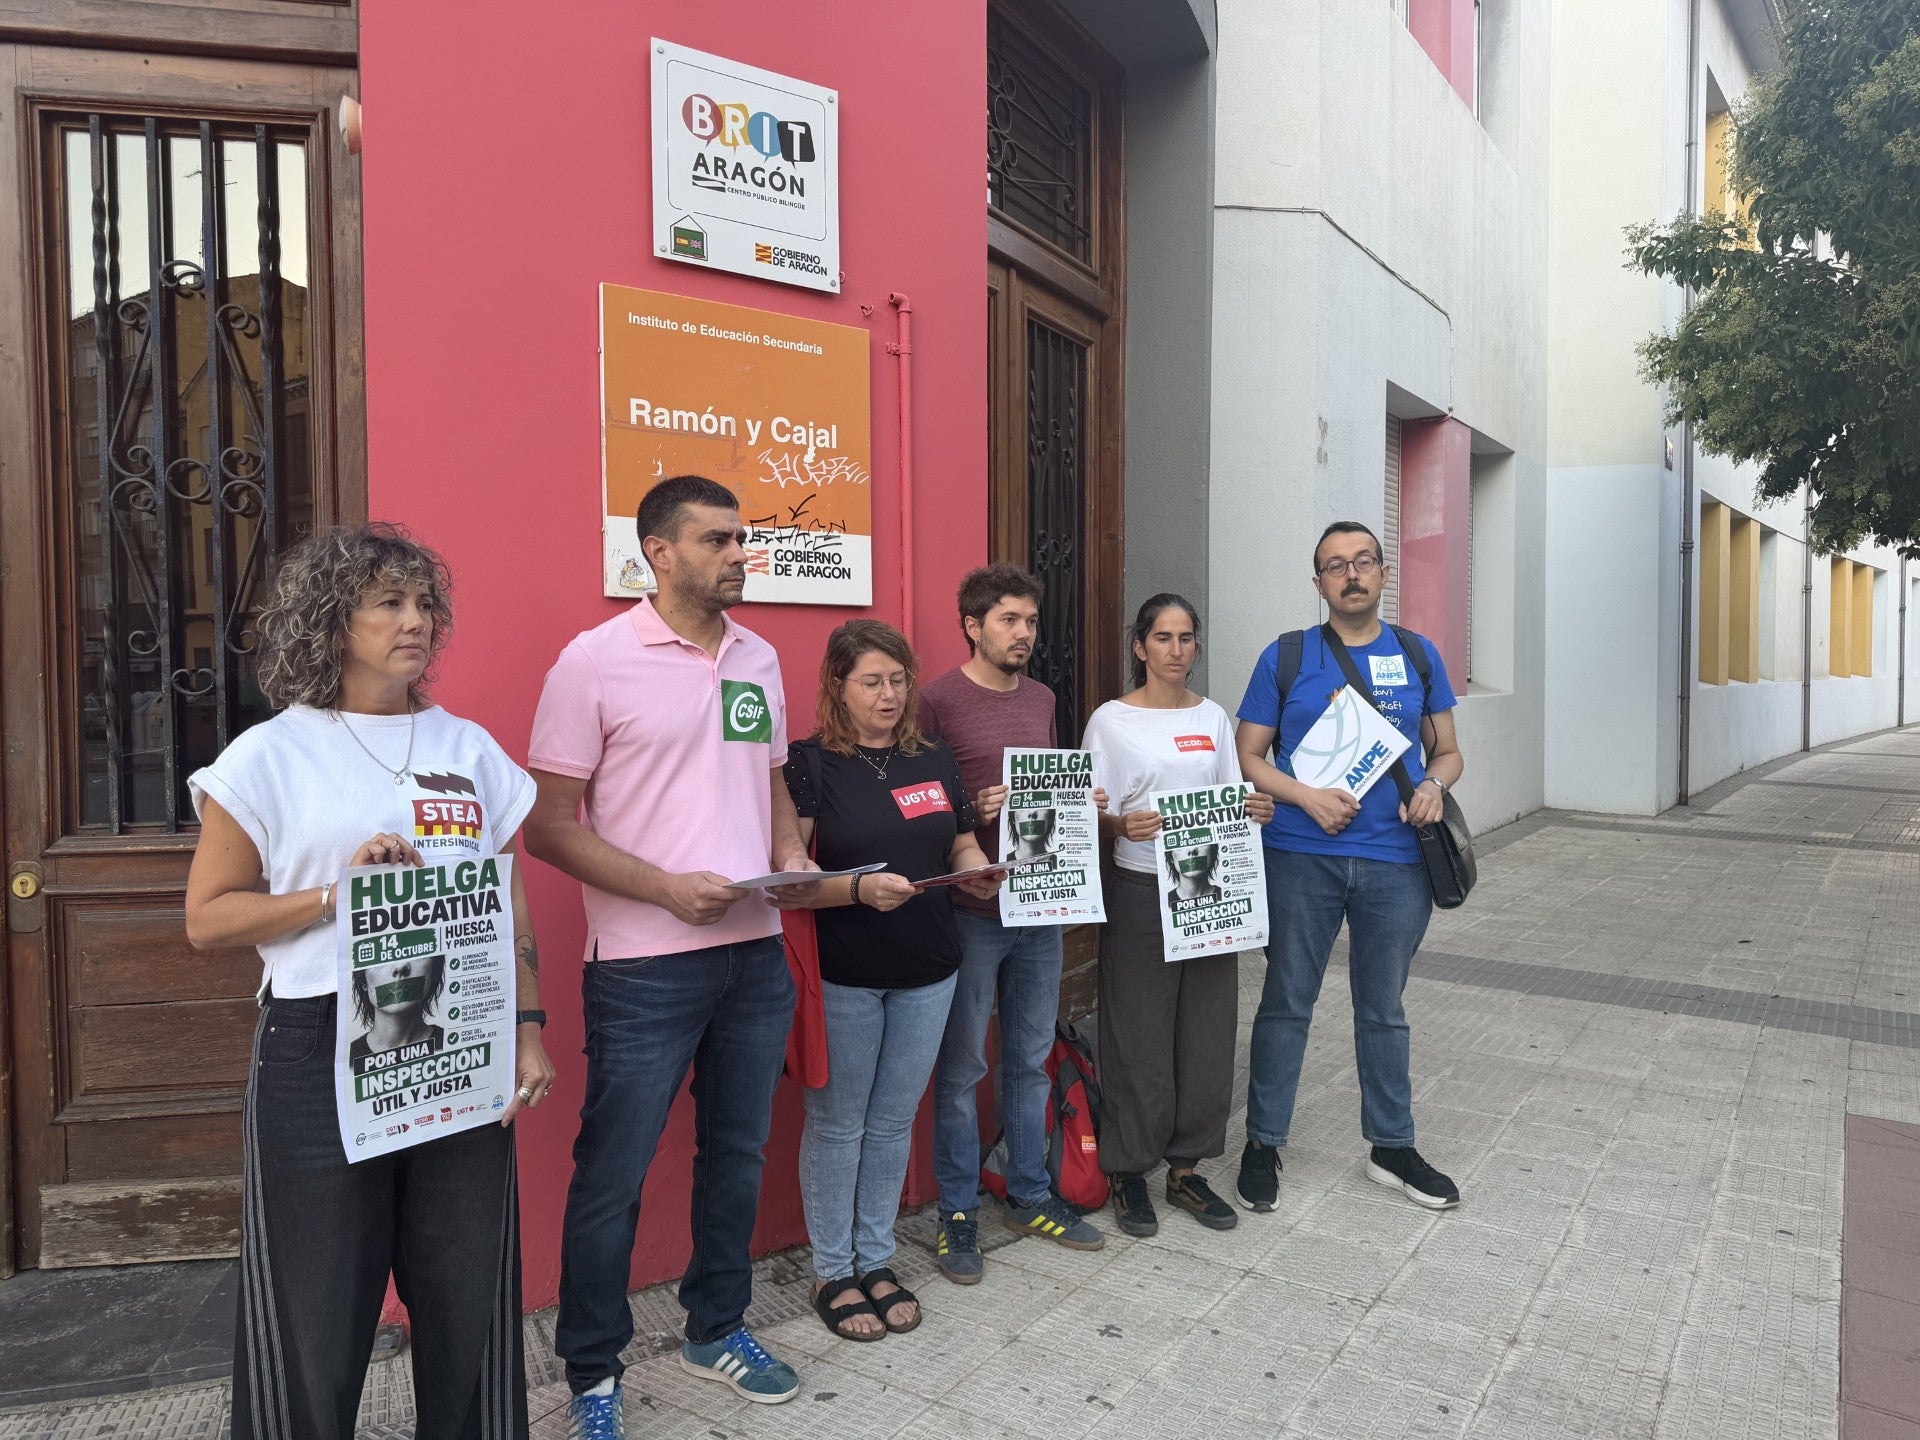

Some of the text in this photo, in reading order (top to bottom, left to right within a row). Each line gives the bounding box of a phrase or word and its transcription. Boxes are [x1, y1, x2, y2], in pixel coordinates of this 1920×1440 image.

[692, 95, 806, 161] BRIT
[692, 152, 805, 198] ARAGÓN
[727, 187, 805, 210] CENTRO PÚBLICO BILINGÜE
[772, 247, 820, 264] GOBIERNO
[773, 257, 785, 267] DE
[628, 312, 823, 355] Instituto de Educación Secundaria
[630, 397, 837, 452] Ramón y Cajal
[774, 549, 842, 565] GOBIERNO
[774, 564, 792, 577] DE
[1376, 671, 1404, 679] ANPE
[738, 704, 764, 719] CSIF
[1011, 753, 1093, 775] HUELGA
[1346, 739, 1389, 790] ANPE
[1011, 773, 1092, 791] EDUCATIVA
[899, 791, 927, 806] UGT
[1023, 793, 1032, 801] 14
[1057, 791, 1085, 800] HUESCA
[1158, 785, 1249, 816] HUELGA
[422, 803, 478, 825] STEA
[1163, 805, 1253, 831] EDUCATIVA
[1179, 831, 1190, 840] 14
[1217, 822, 1248, 834] HUESCA
[1223, 831, 1251, 840] PROVINCIA
[413, 837, 480, 852] INTERSINDICAL
[1188, 836, 1212, 845] OCTUBRE
[1014, 863, 1051, 874] POR UNA
[351, 858, 500, 910] HUELGA
[1012, 871, 1083, 891] INSPECCIÓN
[1019, 888, 1077, 903] ÚTIL Y JUSTA
[1177, 896, 1214, 911] POR UNA
[351, 889, 502, 936] EDUCATIVA
[1176, 900, 1249, 926] INSPECCIÓN
[445, 919, 494, 939] HUESCA
[1183, 917, 1243, 937] ÚTIL Y JUSTA
[380, 934, 398, 950] 14
[446, 933, 498, 949] Y PROVINCIA
[381, 942, 434, 961] DE OCTUBRE
[462, 975, 491, 985] UNIFICACIÓN
[469, 982, 492, 990] CRITERIOS
[475, 986, 500, 994] PROVINCIAS
[480, 1004, 505, 1013] SANCIONES
[485, 998, 506, 1006] EXTERNA
[462, 1014, 487, 1022] IMPUESTAS
[461, 1030, 497, 1042] INSPECTOR JEFE
[364, 1043, 430, 1071] POR UNA
[361, 1047, 485, 1098] INSPECCIÓN
[373, 1074, 472, 1116] ÚTIL Y JUSTA
[457, 1107, 468, 1115] UGT
